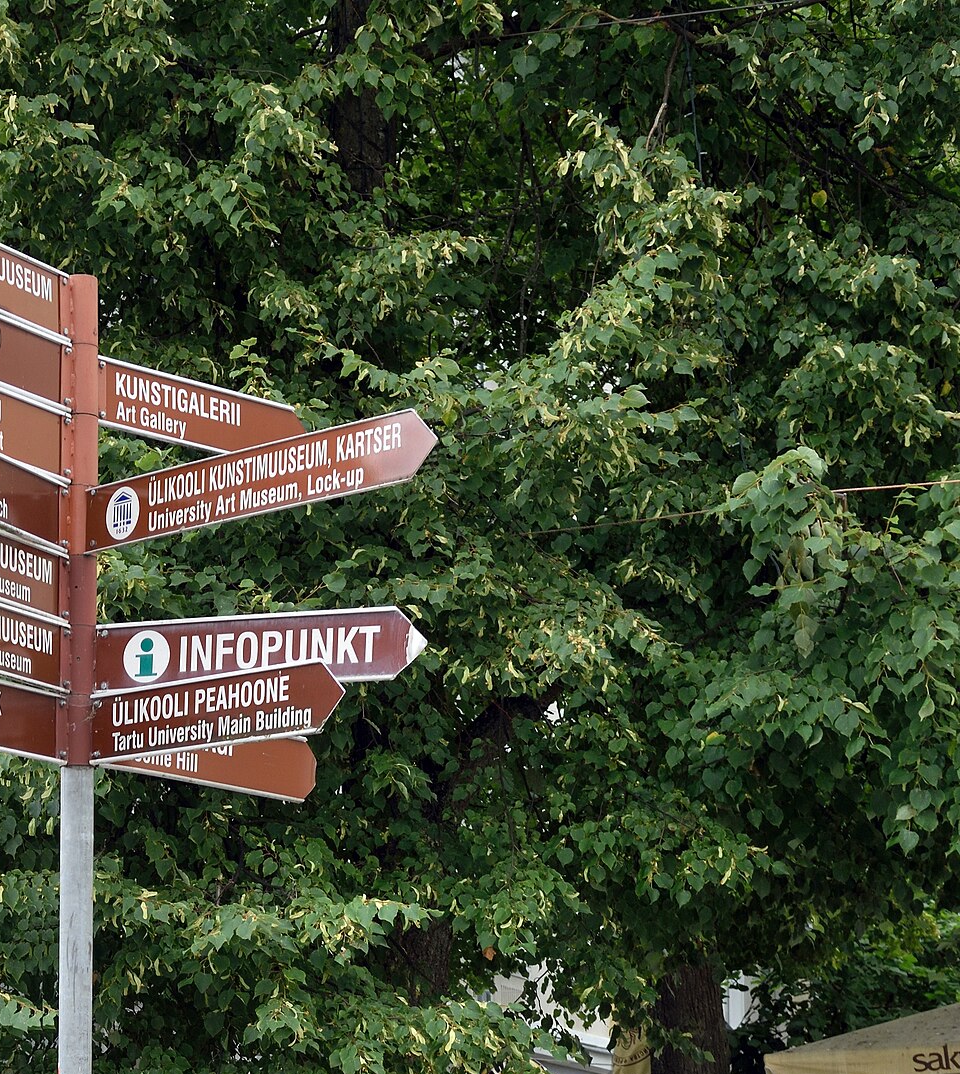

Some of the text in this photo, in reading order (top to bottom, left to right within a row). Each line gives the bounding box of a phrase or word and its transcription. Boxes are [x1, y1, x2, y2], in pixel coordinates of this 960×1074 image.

[114, 372, 241, 428] KUNSTIGALERII
[115, 401, 187, 440] Art Gallery
[147, 422, 402, 508] ÜLIKOOLI KUNSTIMUUSEUM, KARTSER
[147, 465, 365, 533] University Art Museum, Lock-up
[178, 625, 382, 673] INFOPUNKT
[111, 674, 291, 728] ÜLIKOOLI PEAHOONE
[111, 705, 312, 752] Tartu University Main Building
[176, 751, 199, 773] Hill
